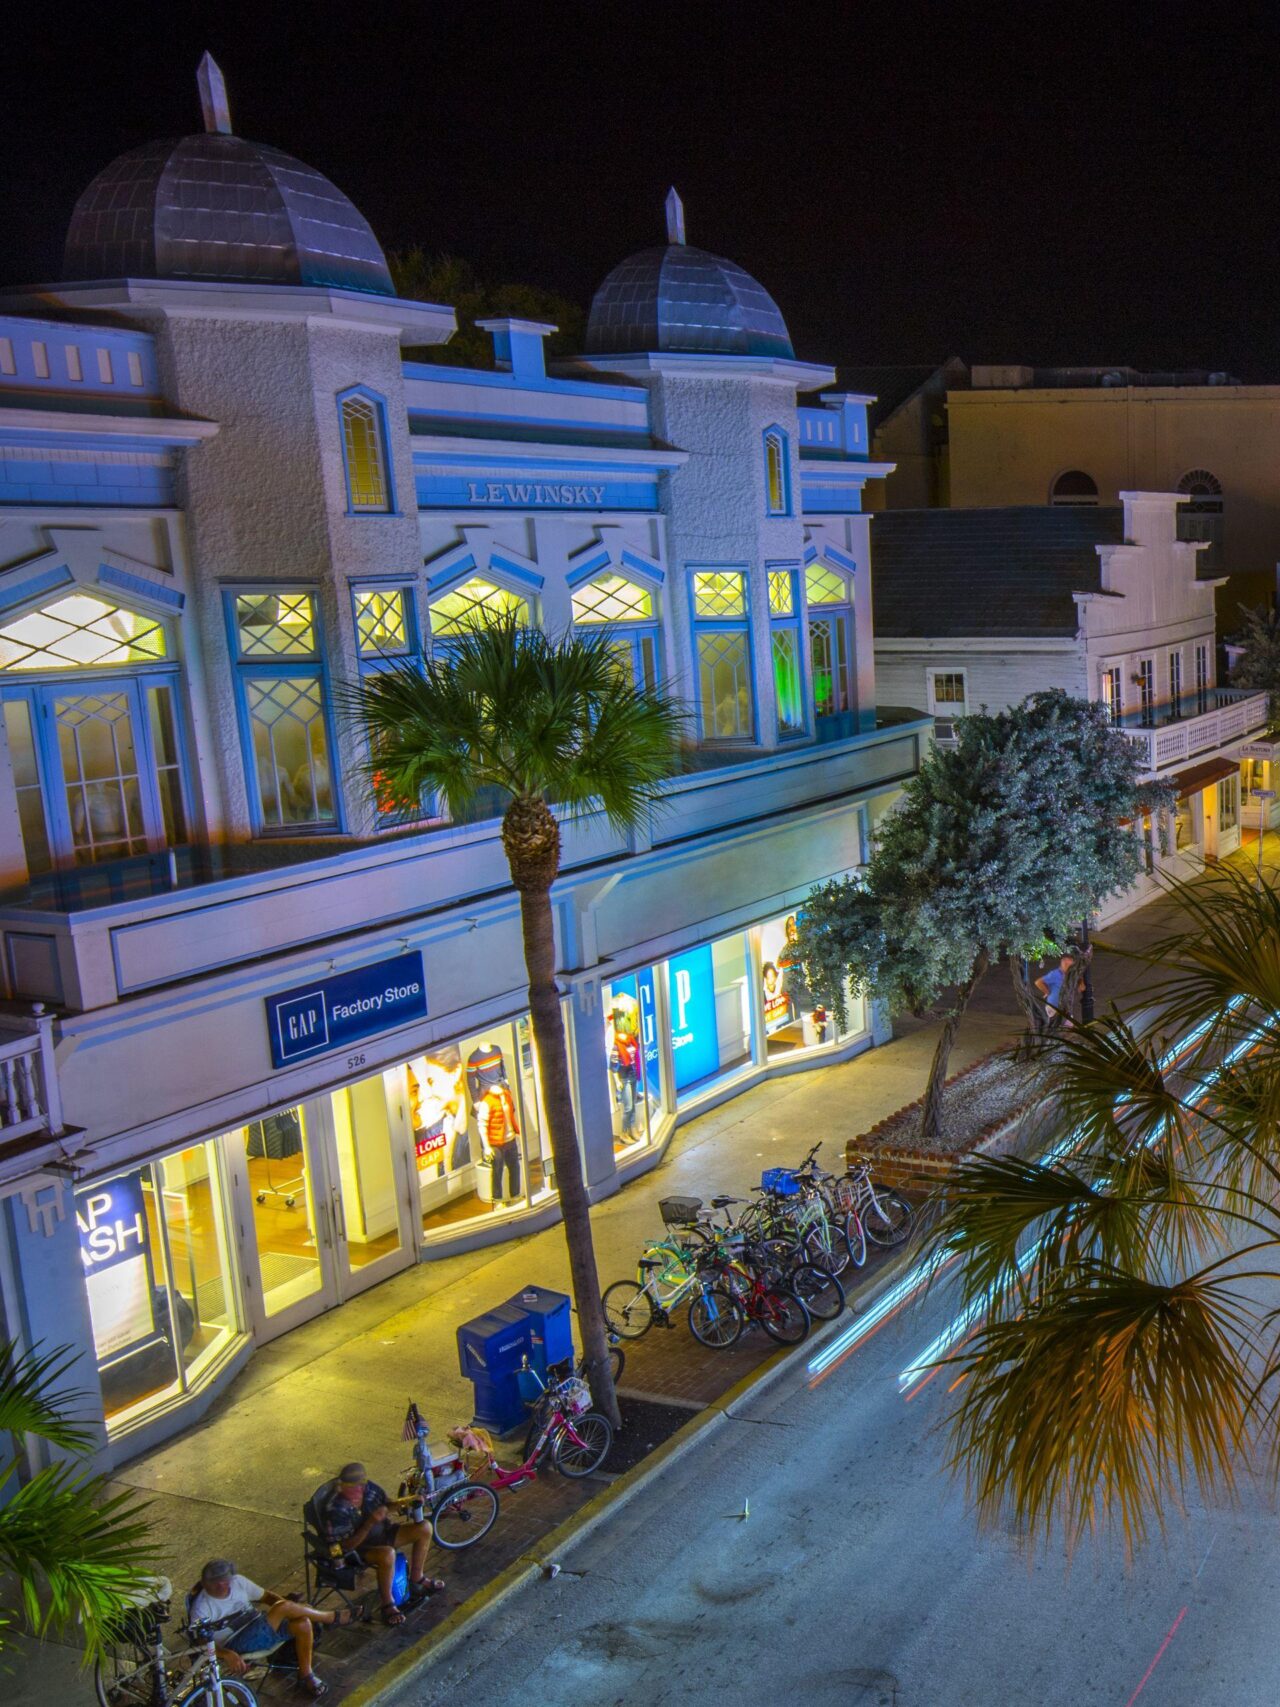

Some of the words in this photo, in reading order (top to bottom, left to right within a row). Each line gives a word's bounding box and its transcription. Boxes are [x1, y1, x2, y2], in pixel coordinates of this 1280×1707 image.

[468, 482, 606, 504] LEWINSKY
[288, 1009, 318, 1041] GAP
[332, 993, 383, 1022] Factory
[384, 982, 420, 1003] Store
[347, 1053, 366, 1070] 526
[419, 1134, 446, 1155] LOVE
